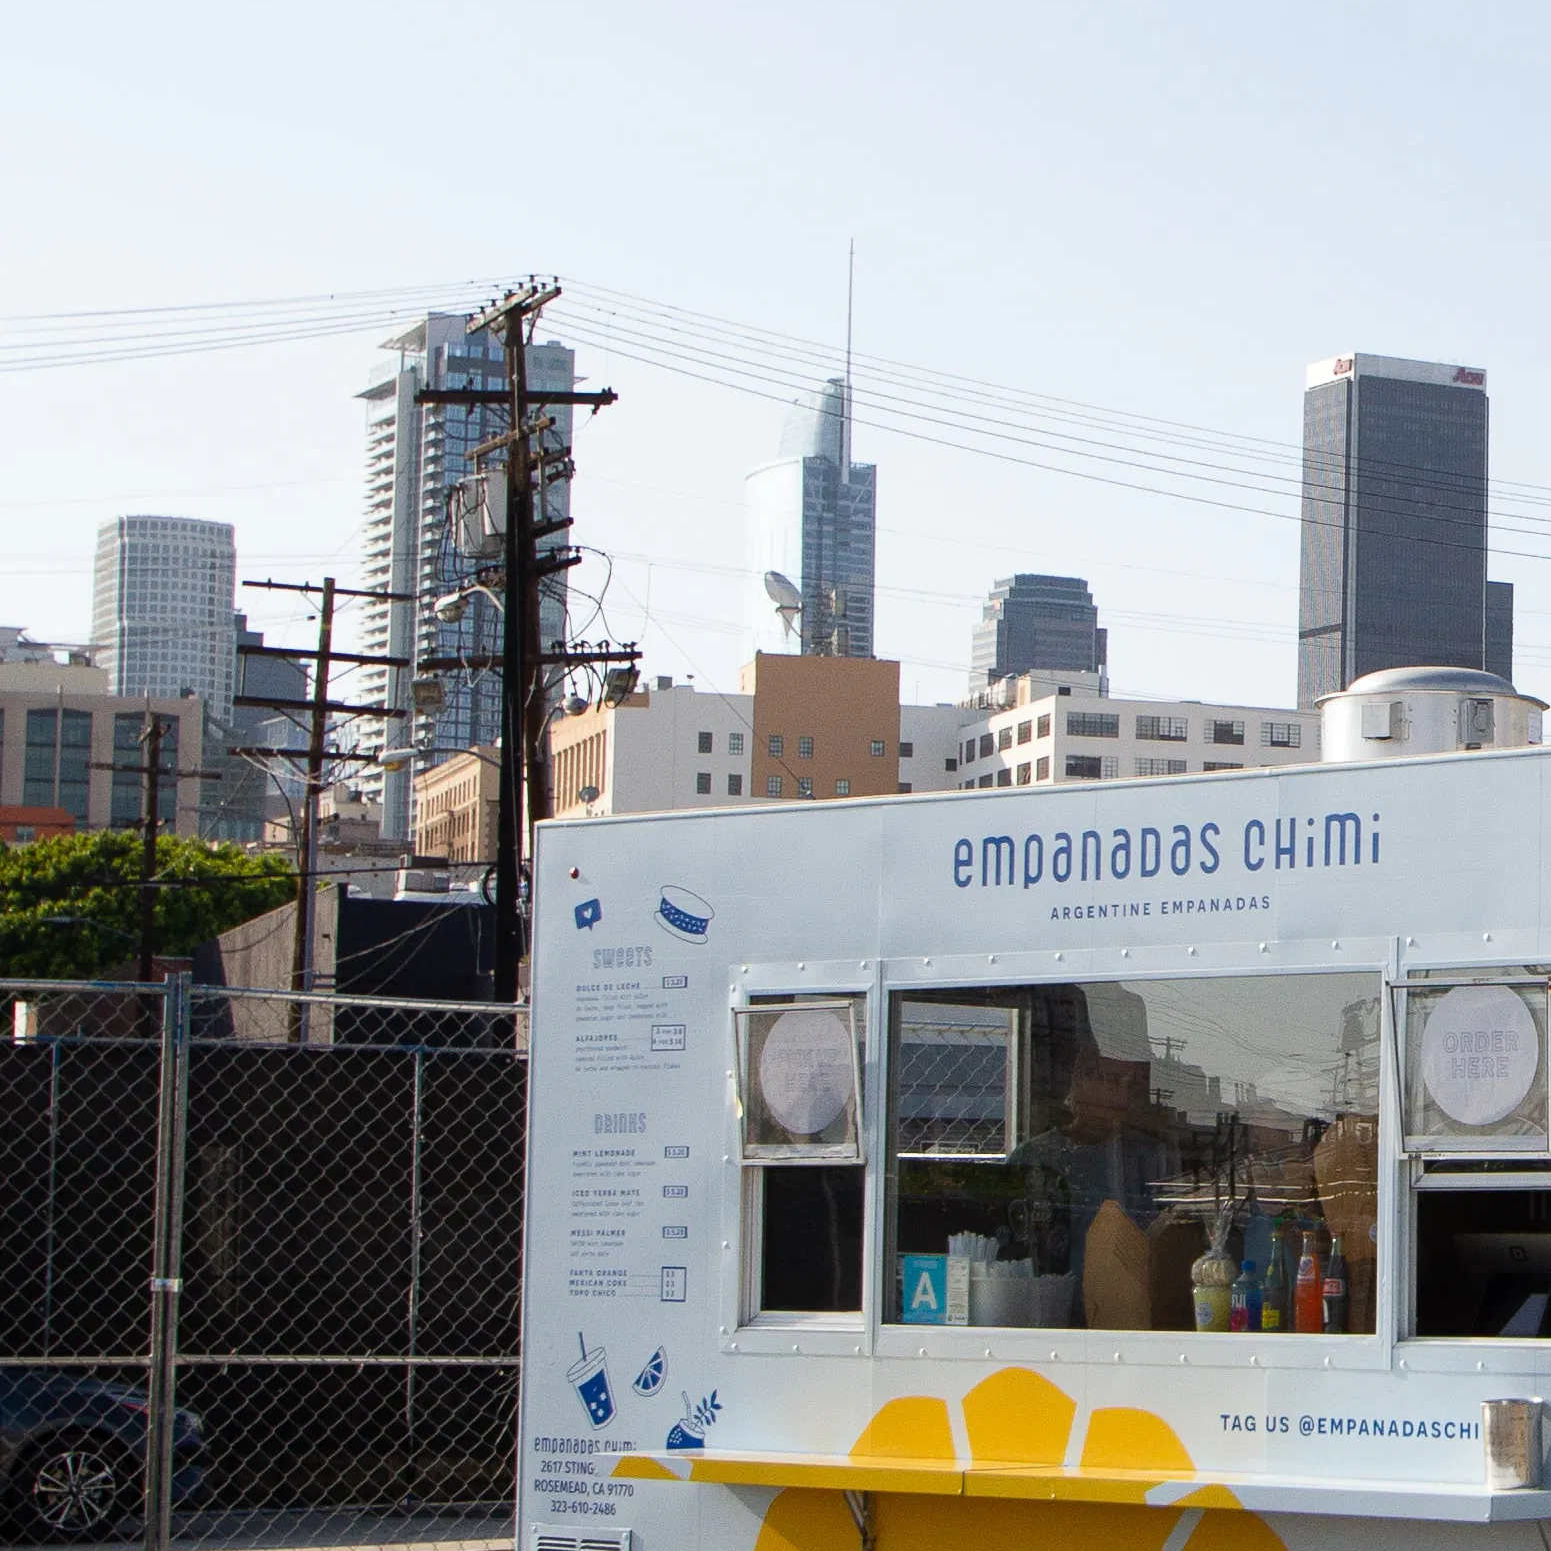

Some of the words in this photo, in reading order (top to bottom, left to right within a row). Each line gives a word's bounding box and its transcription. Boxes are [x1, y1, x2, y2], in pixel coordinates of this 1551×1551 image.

[1049, 902, 1151, 921] ARGENTINE
[1160, 895, 1269, 916] EMPANADAS
[1442, 1029, 1519, 1053] ORDER
[1450, 1056, 1510, 1079] HERE
[573, 1149, 591, 1157] MINT
[595, 1149, 635, 1157] LEMONADE
[572, 1189, 590, 1197] ICED
[570, 1229, 593, 1237] MESSI
[569, 1269, 593, 1277] FANTA
[596, 1269, 628, 1277] ORANGE
[569, 1279, 603, 1287] MEXICAN
[606, 1279, 627, 1287] COKE
[911, 1271, 938, 1310] A
[569, 1289, 590, 1297] TOPO
[592, 1289, 616, 1297] CHICO
[1219, 1413, 1256, 1433] TAG
[1265, 1415, 1289, 1434] US
[1298, 1414, 1478, 1440] @EMPANADASCHI
[540, 1460, 562, 1474] 2617
[564, 1461, 597, 1476] STING
[534, 1479, 590, 1496] ROSEMEAD,
[592, 1481, 605, 1496] CA
[606, 1482, 635, 1498] 91770
[550, 1499, 617, 1517] 323-610-2486
